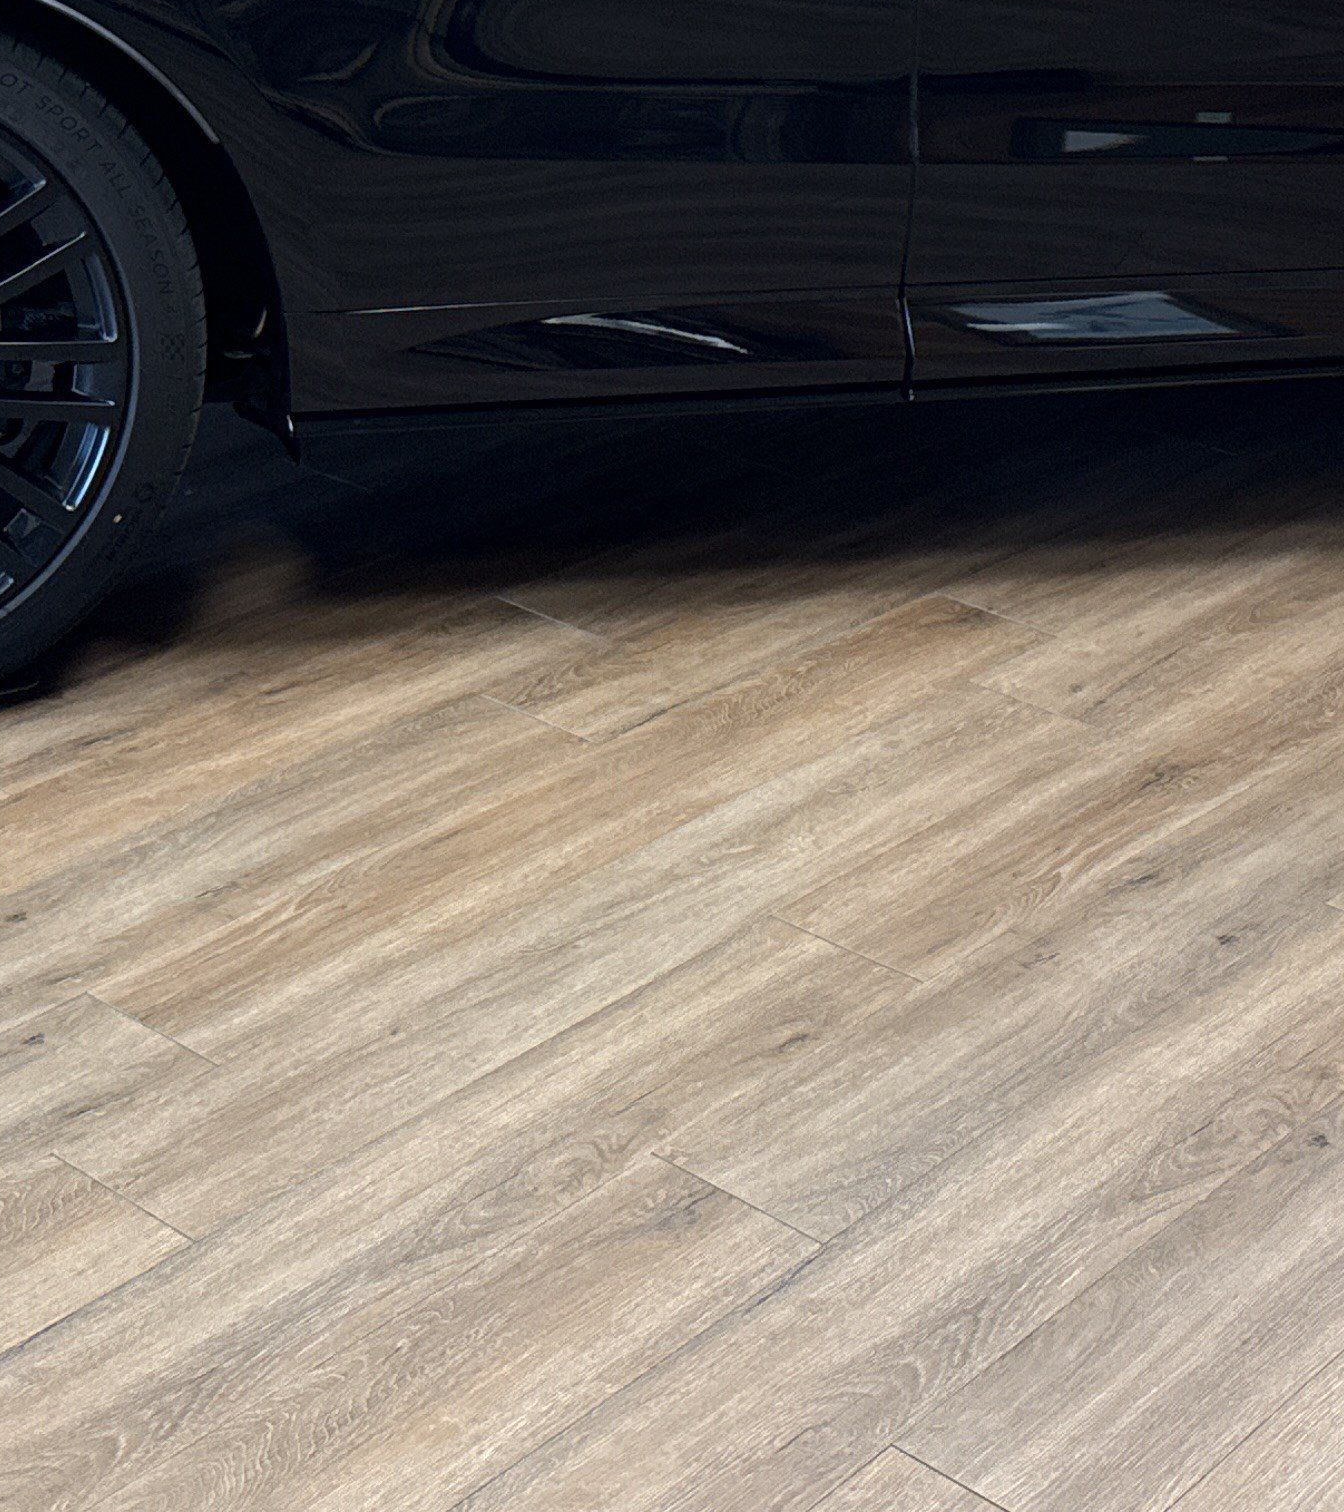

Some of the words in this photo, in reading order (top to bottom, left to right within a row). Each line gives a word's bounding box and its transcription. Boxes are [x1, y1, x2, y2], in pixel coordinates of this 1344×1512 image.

[34, 95, 104, 152] SPORT
[97, 159, 132, 199] ALL
[128, 204, 174, 296] SEASON
